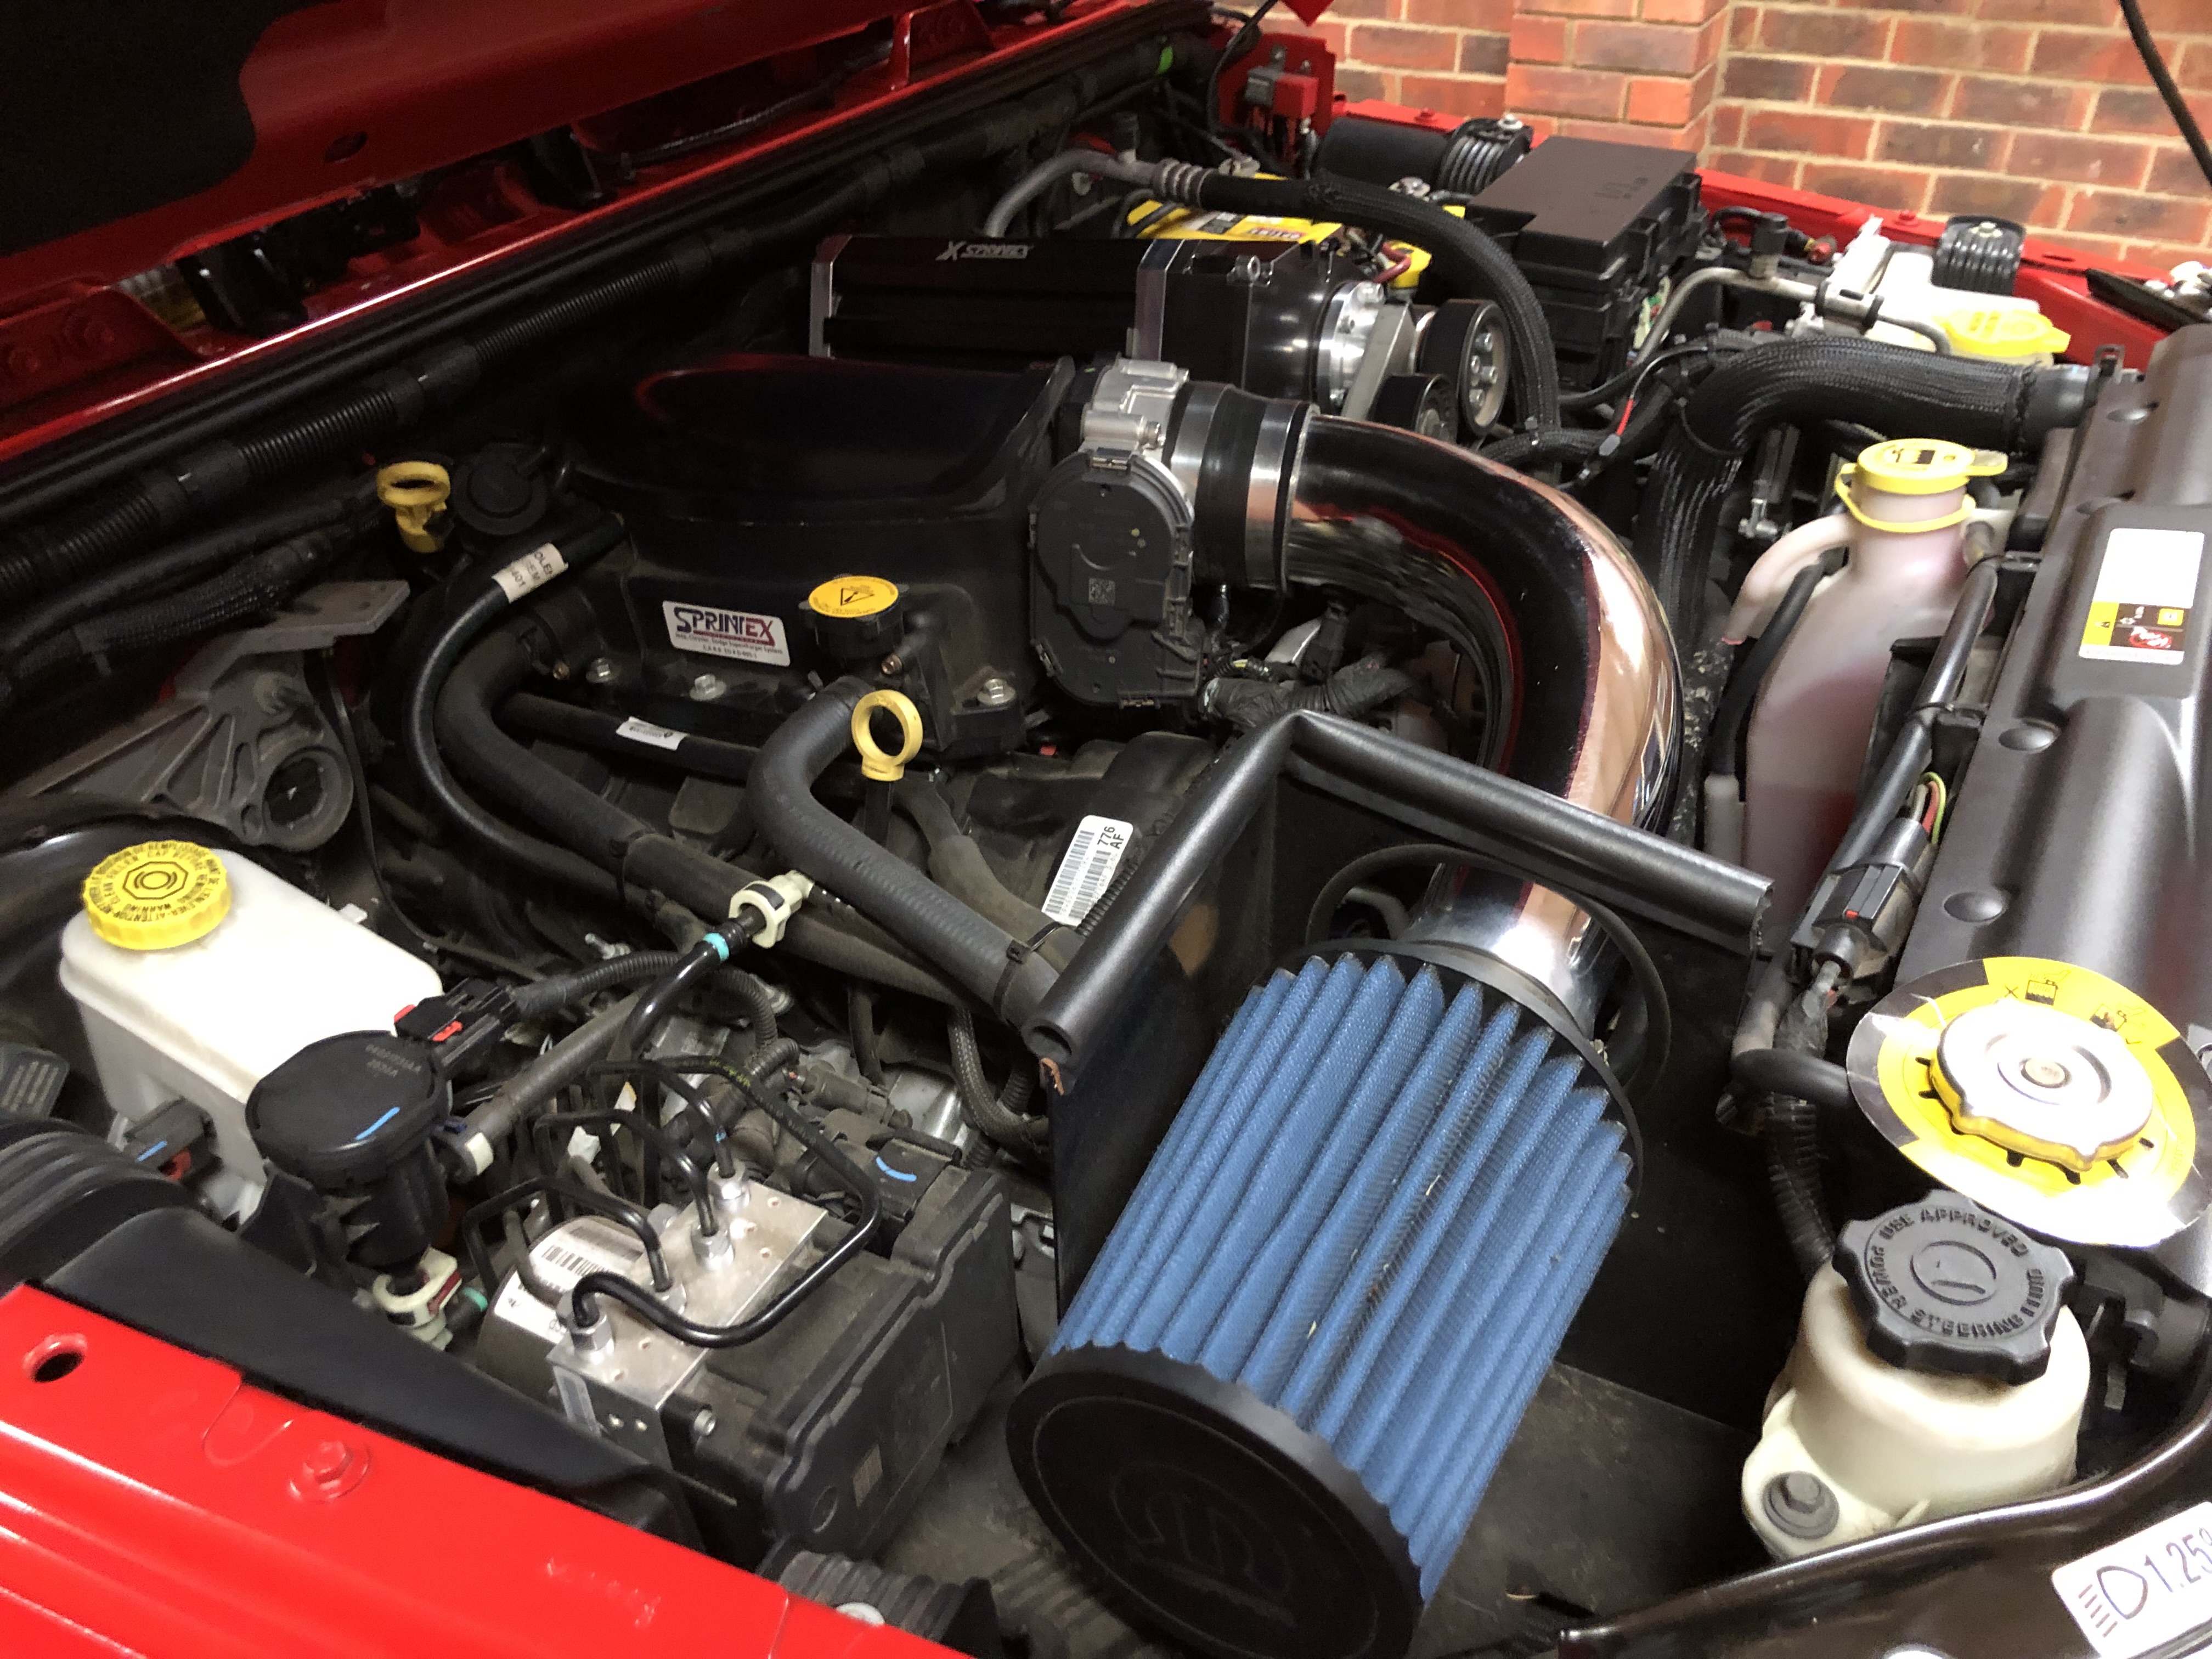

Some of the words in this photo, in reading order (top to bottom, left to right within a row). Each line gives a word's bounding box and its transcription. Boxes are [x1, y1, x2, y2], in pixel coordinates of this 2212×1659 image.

[674, 606, 775, 647] SPRINTEX
[1097, 826, 1115, 846] 776
[1110, 834, 1124, 849] AF
[125, 903, 172, 912] WARNING
[1880, 1213, 1915, 1240] USE
[1920, 1207, 2030, 1257] APPROVED
[1870, 1245, 1908, 1309] POWER
[1910, 1308, 2024, 1338] STEERING
